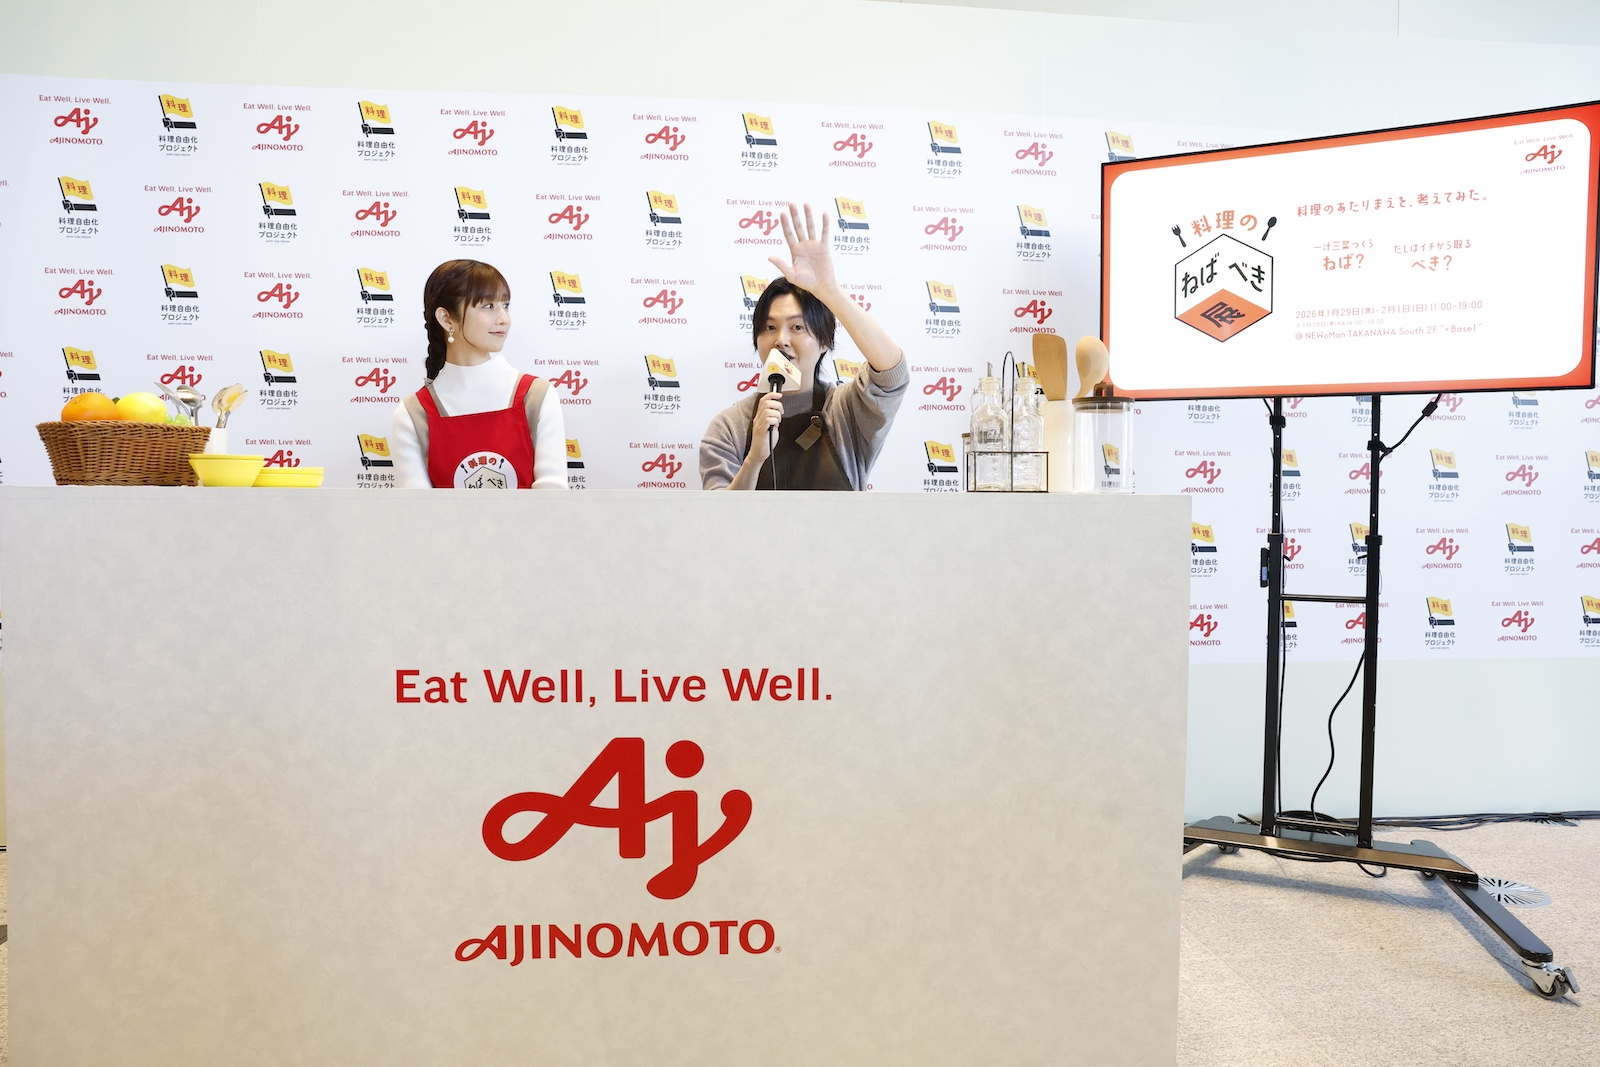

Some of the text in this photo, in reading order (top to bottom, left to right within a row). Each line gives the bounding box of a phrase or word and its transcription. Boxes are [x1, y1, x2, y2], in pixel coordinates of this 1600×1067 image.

[39, 94, 52, 102] Eat
[53, 95, 73, 103] Well,
[74, 96, 91, 104] Live
[165, 100, 188, 113] 料理
[559, 111, 579, 124] 料理
[934, 126, 953, 139] 料理
[49, 137, 103, 145] AJINOMOTO
[159, 135, 198, 144] 料理自由化
[159, 144, 198, 152] プロジェクト
[448, 148, 498, 156] AJINOMOTO
[551, 145, 588, 153] 料理自由化
[551, 154, 588, 162] プロジェクト
[828, 160, 877, 168] AJINOMOTO
[927, 159, 962, 167] 料理自由化
[927, 167, 962, 175] プロジェクト
[1520, 165, 1566, 174] AJINOMOTO
[65, 182, 88, 195] 料理
[266, 187, 288, 200] 料理
[653, 195, 673, 208] 料理
[1296, 188, 1488, 218] 料理のあたりまえを、考えてみた。
[1024, 210, 1042, 222] 料理
[59, 217, 99, 226] 料理自由化
[259, 222, 298, 230] 料理自由化
[1190, 210, 1258, 237] 料理の
[59, 226, 99, 234] プロジェクト
[645, 229, 683, 238] 料理自由化
[259, 231, 297, 239] プロジェクト
[645, 238, 682, 246] プロジェクト
[1016, 242, 1052, 250] 料理自由化
[1016, 250, 1052, 259] プロジェクト
[364, 273, 385, 286] 料理
[1182, 252, 1220, 298] ねば
[1228, 262, 1265, 292] べき
[933, 285, 952, 299] 料理
[54, 308, 106, 316] AJINOMOTO
[357, 316, 394, 324] プロジェクト
[638, 317, 687, 325] AJINOMOTO
[925, 318, 961, 327] 料理自由化
[925, 327, 961, 335] プロジェクト
[1295, 332, 1303, 340] @
[1305, 331, 1345, 340] NEWoMan
[1348, 328, 1396, 338] TAKANAWA
[1399, 326, 1424, 336] South
[1426, 326, 1438, 334] 2F
[267, 354, 288, 368] 料理
[651, 359, 672, 372] 料理
[259, 389, 298, 397] 料理自由化
[259, 398, 298, 406] プロジェクト
[350, 396, 400, 404] AJINOMOTO
[644, 394, 681, 402] 料理自由化
[644, 402, 681, 410] プロジェクト
[1435, 452, 1453, 465] 料理
[637, 481, 687, 489] AJINOMOTO
[1431, 601, 1449, 612] 料理
[396, 668, 832, 708] Eat Well, Live Well.
[454, 919, 775, 966] AJINOMOTO
